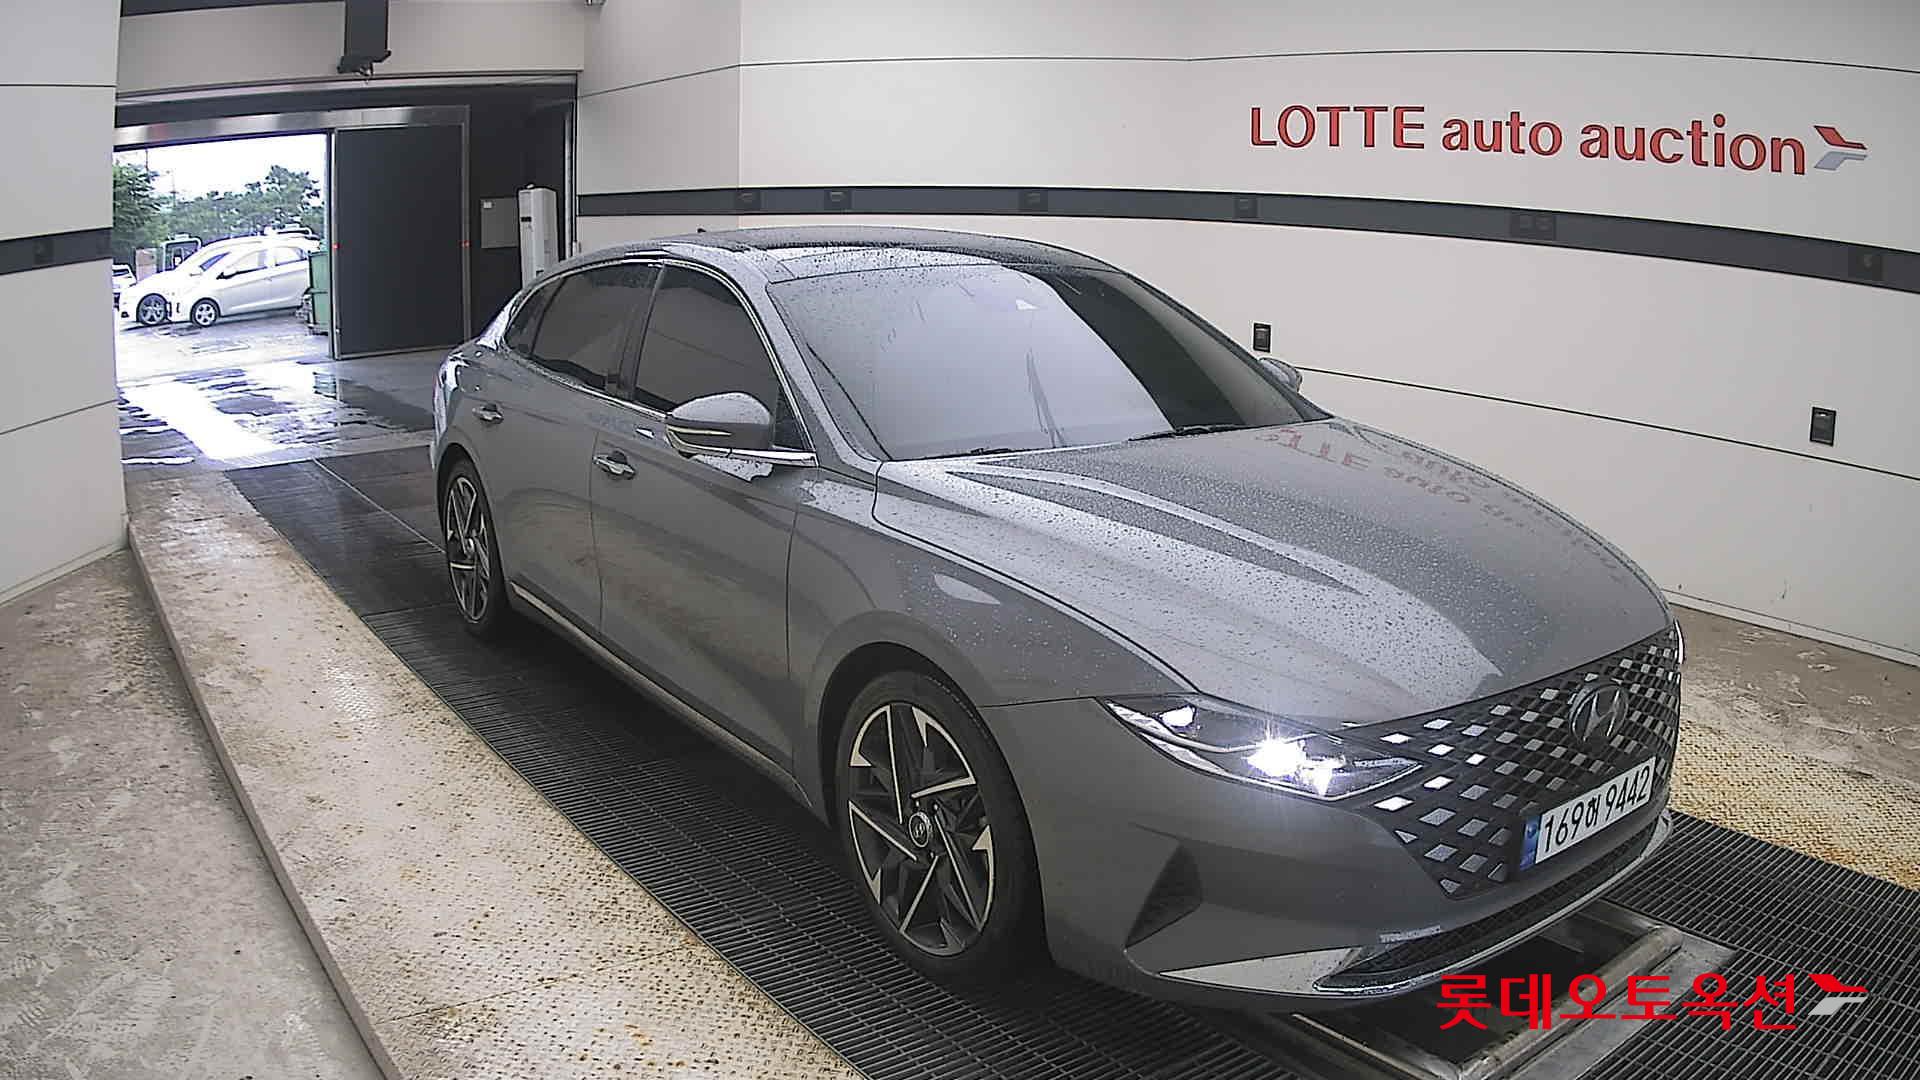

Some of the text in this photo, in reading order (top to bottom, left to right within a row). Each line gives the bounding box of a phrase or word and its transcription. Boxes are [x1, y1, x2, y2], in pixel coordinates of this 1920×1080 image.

[1250, 105, 1806, 175] LOTTE auto auction
[1605, 765, 1650, 821] 9442
